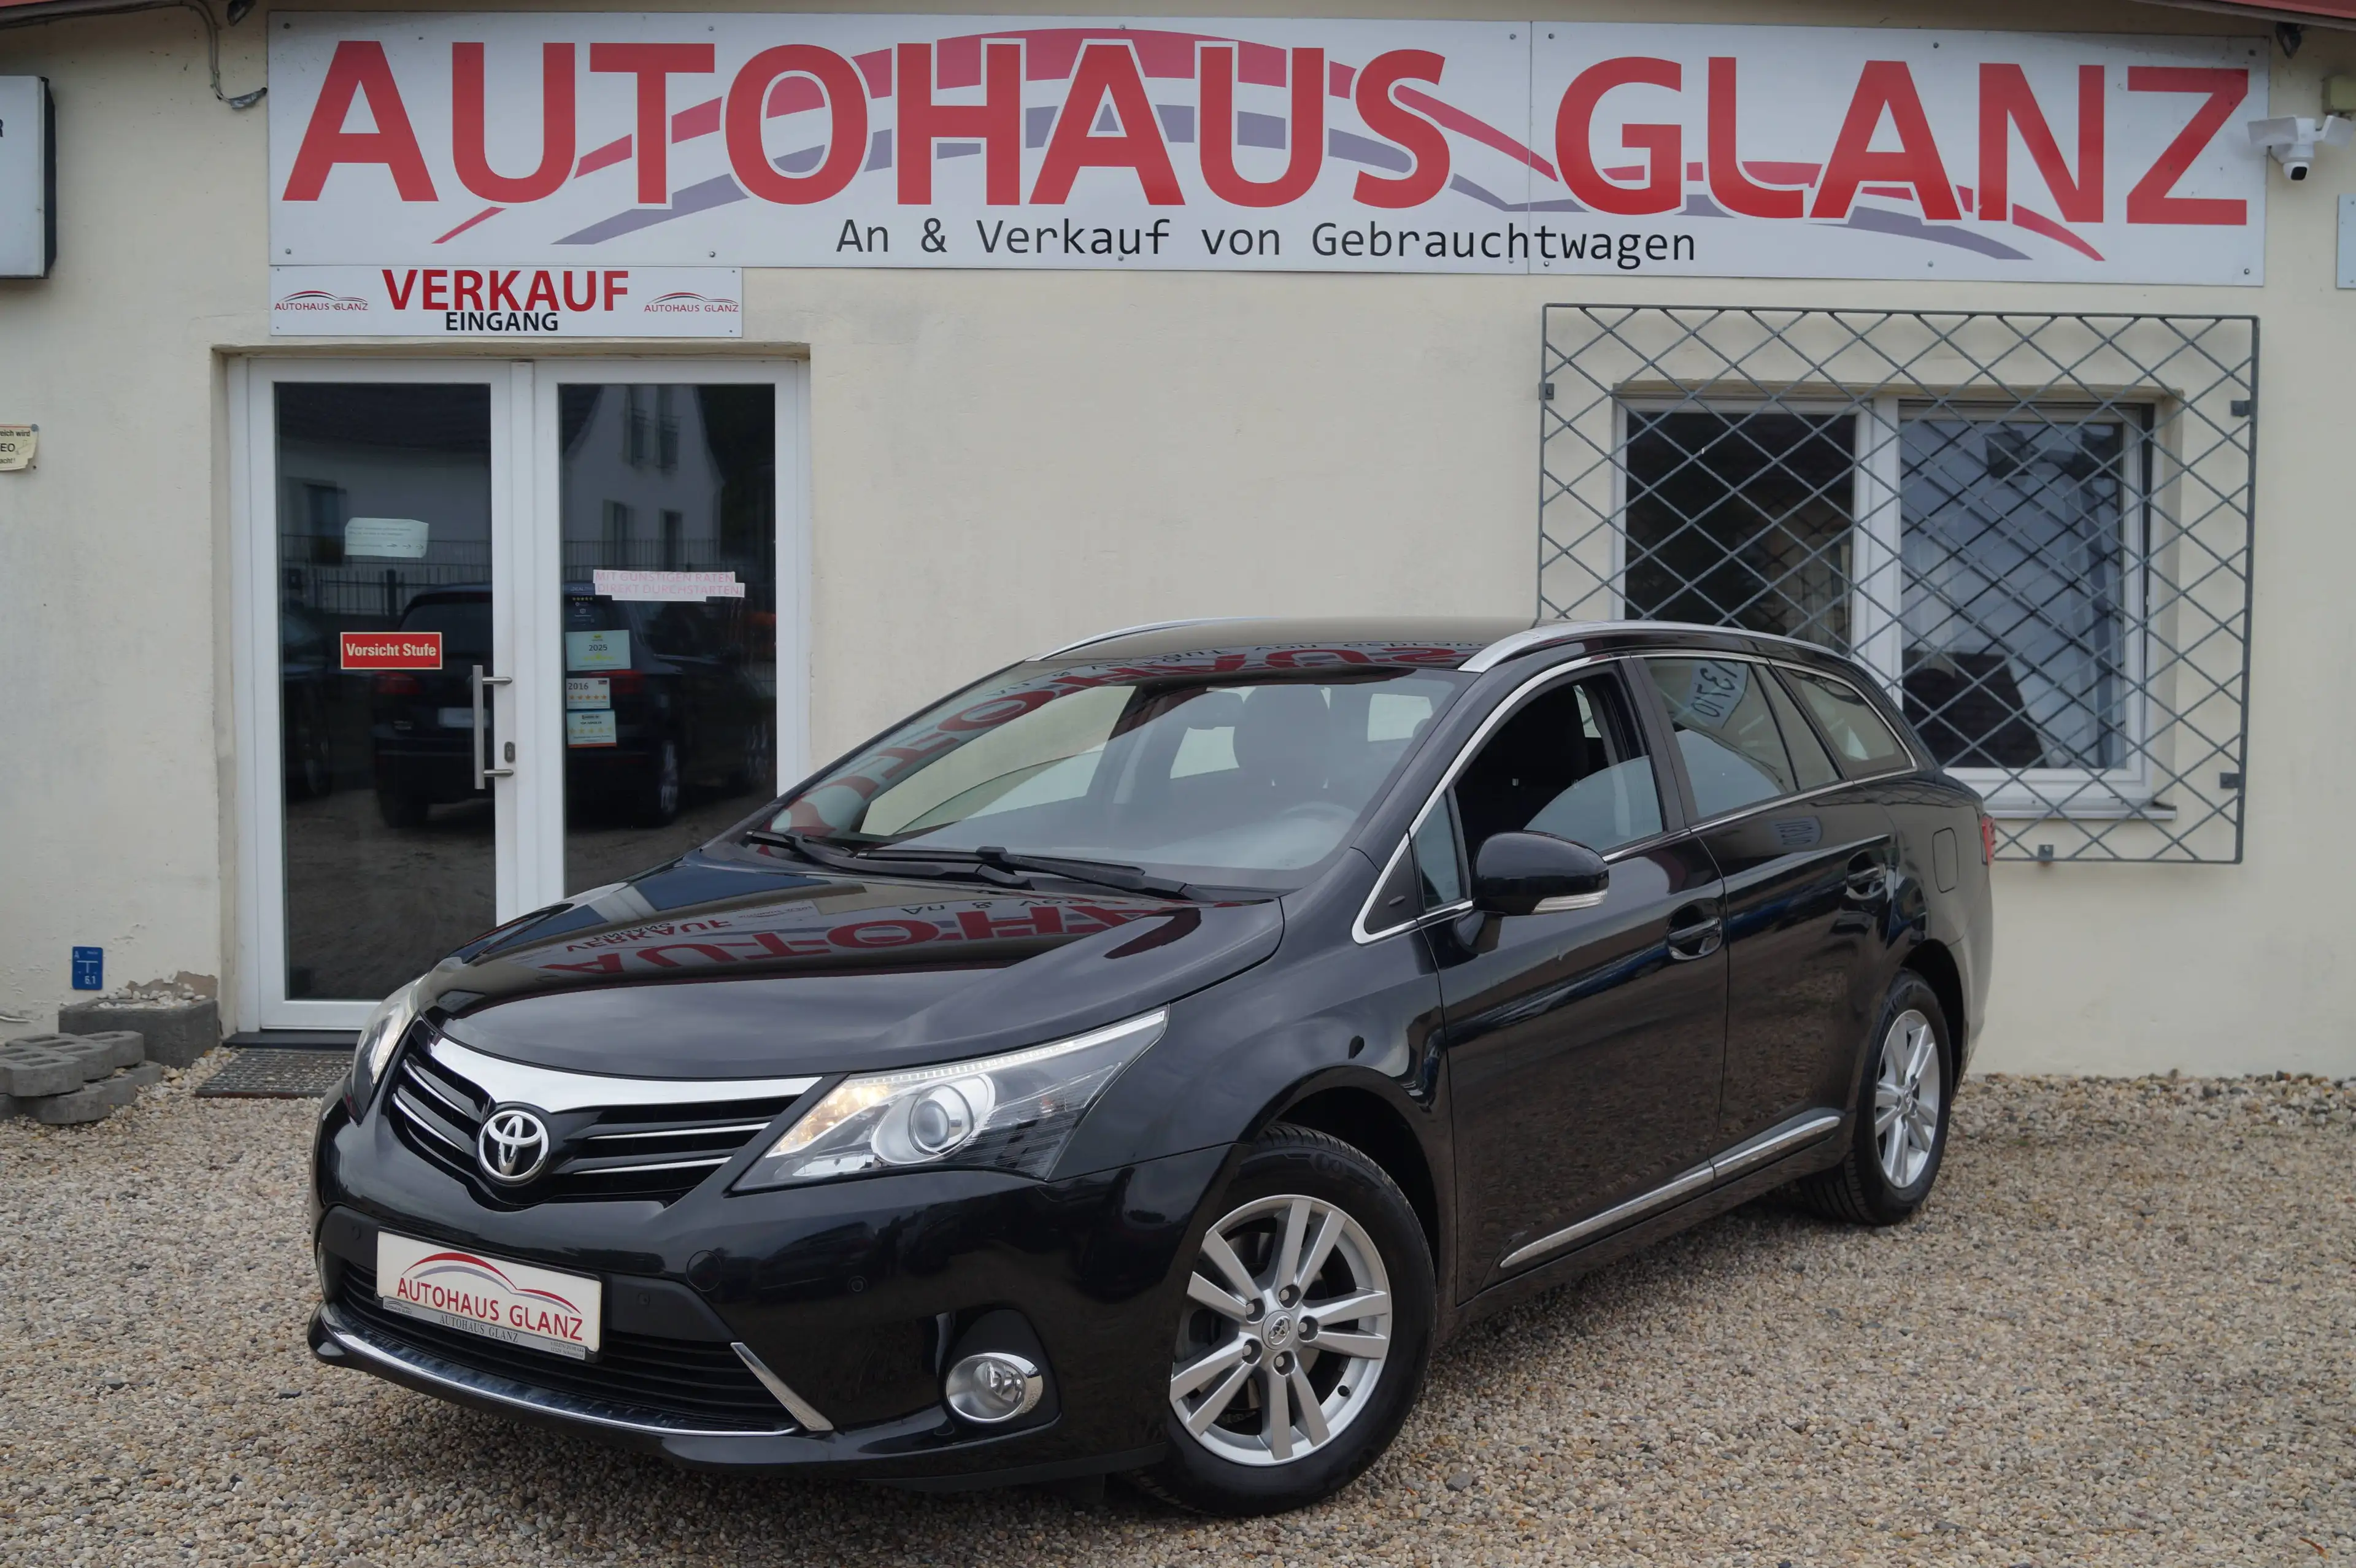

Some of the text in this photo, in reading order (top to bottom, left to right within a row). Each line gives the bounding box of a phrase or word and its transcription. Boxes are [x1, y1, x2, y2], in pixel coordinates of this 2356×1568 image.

[282, 38, 2248, 226] AUTOHAUS GLANZ
[836, 217, 1695, 270] An & Verkauf von Gebrauchtwagen
[382, 269, 629, 312] VERKAUF
[274, 302, 369, 311] AUTOHAUS GLANZ
[445, 312, 558, 331] EINGANG
[595, 571, 613, 581] MIT
[695, 573, 734, 583] RATEN
[597, 583, 743, 596] DIREKT DURCHSTARTEN!
[345, 643, 437, 656] Vorsicht Stufe
[396, 1277, 583, 1342] AUTOHAUS GLANZ
[439, 1314, 519, 1343] AUTOHAUS GLANZ
